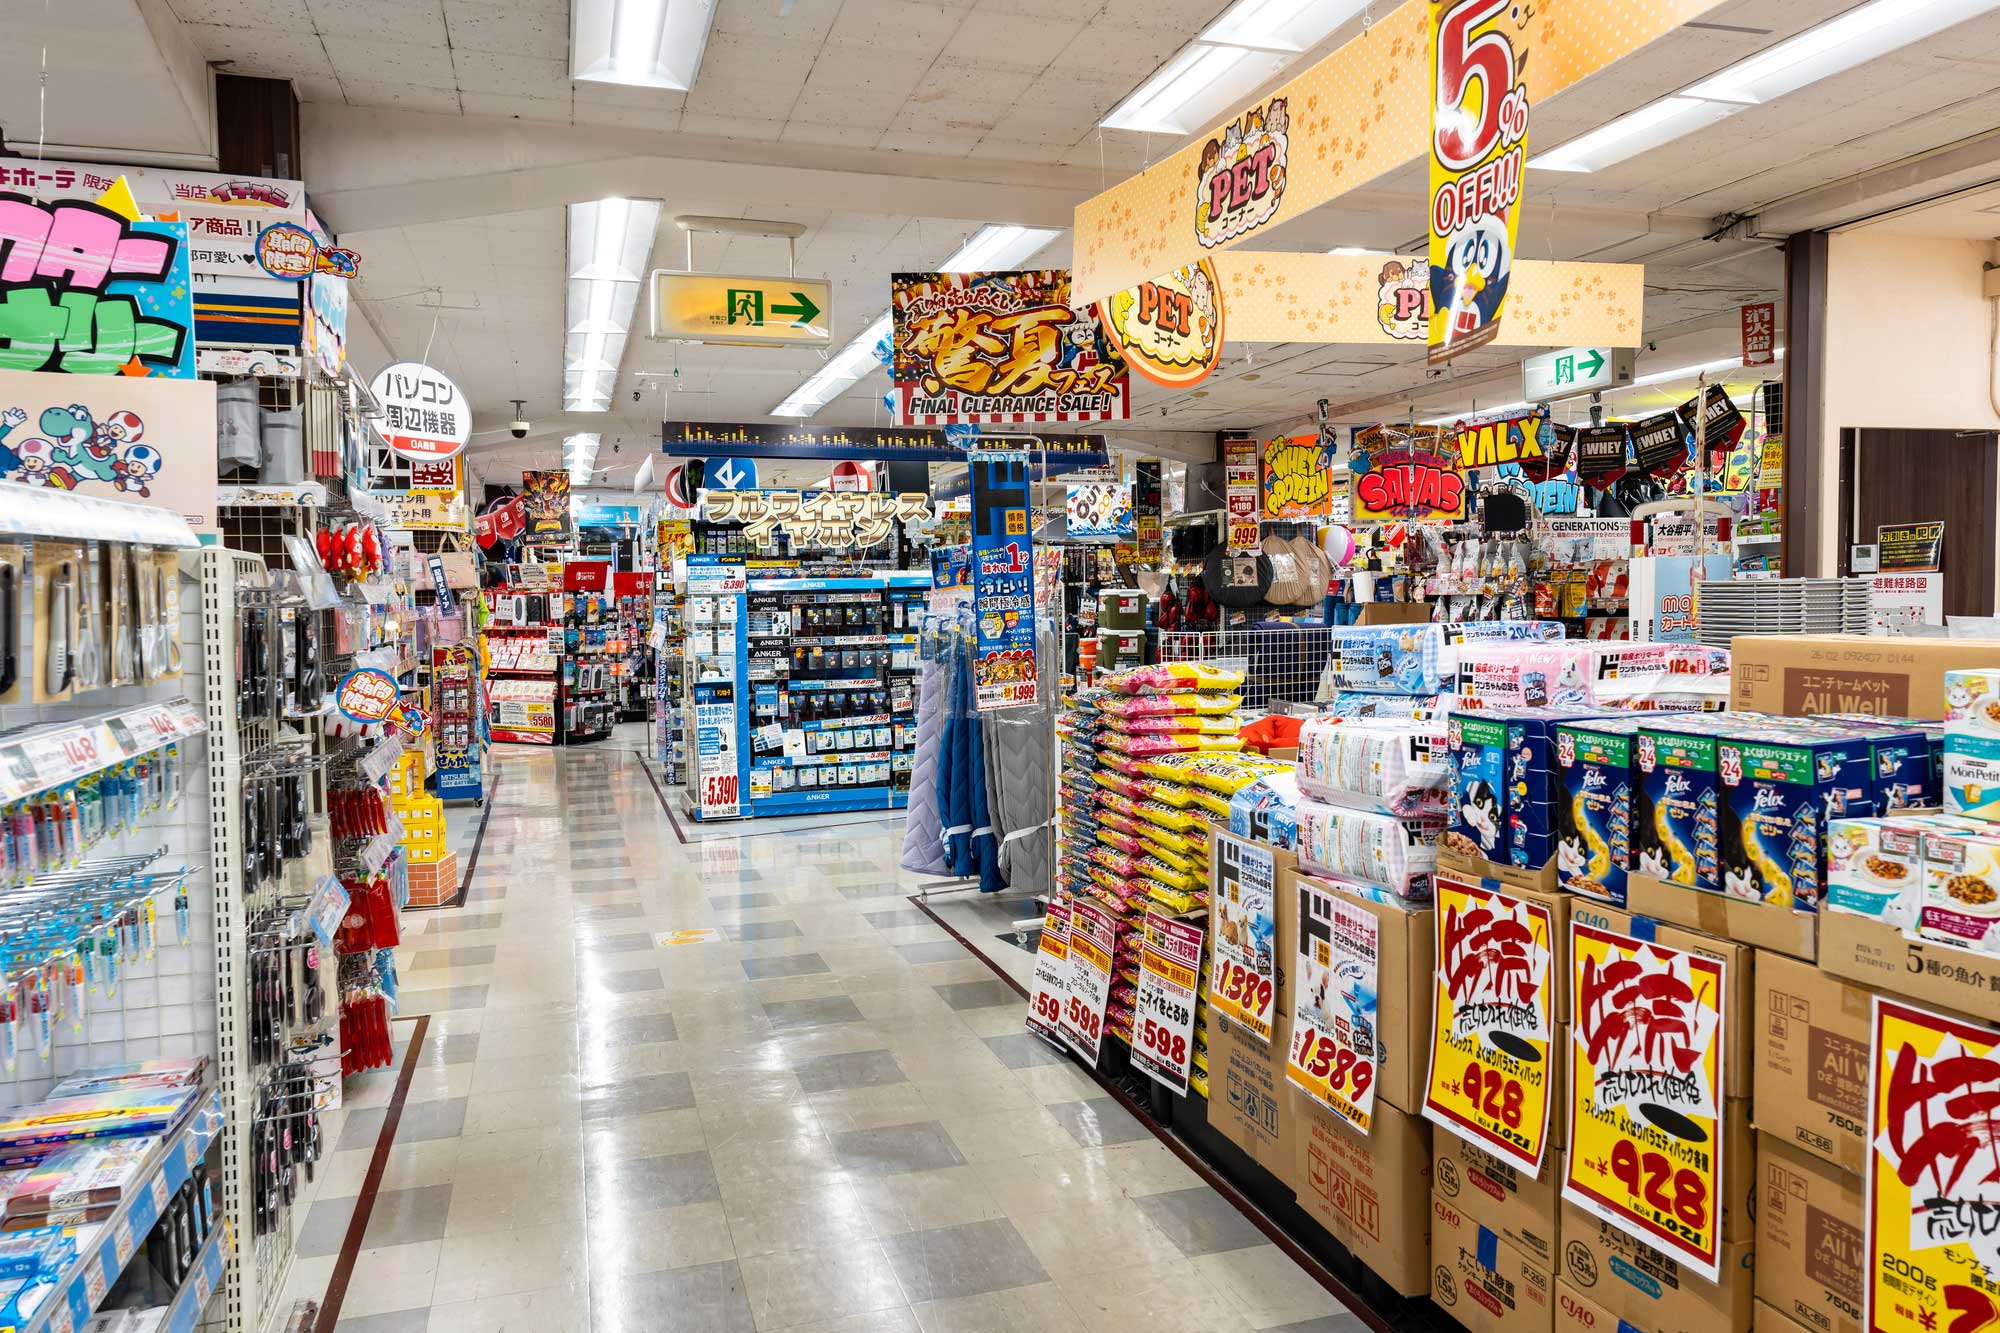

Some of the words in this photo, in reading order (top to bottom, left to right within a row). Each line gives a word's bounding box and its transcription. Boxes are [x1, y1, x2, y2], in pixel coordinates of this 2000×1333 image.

[175, 183, 208, 200] 当店
[1208, 142, 1275, 222] PET
[1222, 206, 1255, 230] コーナー
[1138, 281, 1193, 337] PET
[1745, 307, 1771, 350] 消火器
[385, 373, 453, 405] パソコン
[909, 397, 956, 417] FINAL
[961, 396, 1058, 416] CLEARANCE
[1059, 393, 1112, 413] SALE!
[386, 404, 456, 436] 周辺機器
[1458, 417, 1543, 468] VALX
[1587, 441, 1622, 455] WHEY
[1641, 426, 1676, 448] WHEY
[1271, 445, 1323, 480] WHEY
[1358, 463, 1465, 512] SAVAS
[705, 491, 931, 522] フルワイヤレス
[743, 515, 897, 548] イヤホン
[1233, 527, 1258, 545] 999
[1551, 521, 1620, 532] GENERATIONS
[1657, 523, 1692, 537] 大谷翔平
[1873, 577, 1927, 589] 避難経路図
[1474, 682, 1520, 692] ワンちゃんの足も
[1801, 692, 1831, 714] All
[1838, 693, 1888, 716] Well
[150, 713, 177, 736] 148
[1449, 730, 1462, 743] 24
[63, 737, 98, 767] 148
[1559, 744, 1575, 760] 24
[1640, 747, 1656, 765] 24
[1656, 735, 1712, 752] よくばりバラエティ
[1743, 746, 1808, 763] よくばりバラエティ
[1460, 751, 1483, 770] felix
[1721, 760, 1741, 777] 24
[707, 775, 738, 807] 5,390
[1582, 770, 1608, 789] felix
[1664, 774, 1691, 796] felix
[1753, 788, 1785, 811] felix
[1300, 888, 1331, 957] ド
[1334, 931, 1376, 960] ワンちゃんの足も
[1906, 944, 1985, 988] 5種の魚介
[1219, 958, 1272, 1017] 1,389
[1141, 990, 1189, 1027] ニオイをとる砂
[1298, 1027, 1373, 1103] 1,389
[1823, 1052, 1850, 1077] All
[1600, 1063, 1702, 1106] 売り切れ御免
[1584, 1098, 1617, 1127] フィリックス
[1434, 1201, 1461, 1228] CIAO
[1598, 1235, 1633, 1259] クランキー
[1820, 1231, 1852, 1264] All
[1943, 1247, 1994, 1276] モンプチ
[1522, 1266, 1546, 1288] P-255
[1560, 1295, 1595, 1326] CIAO
